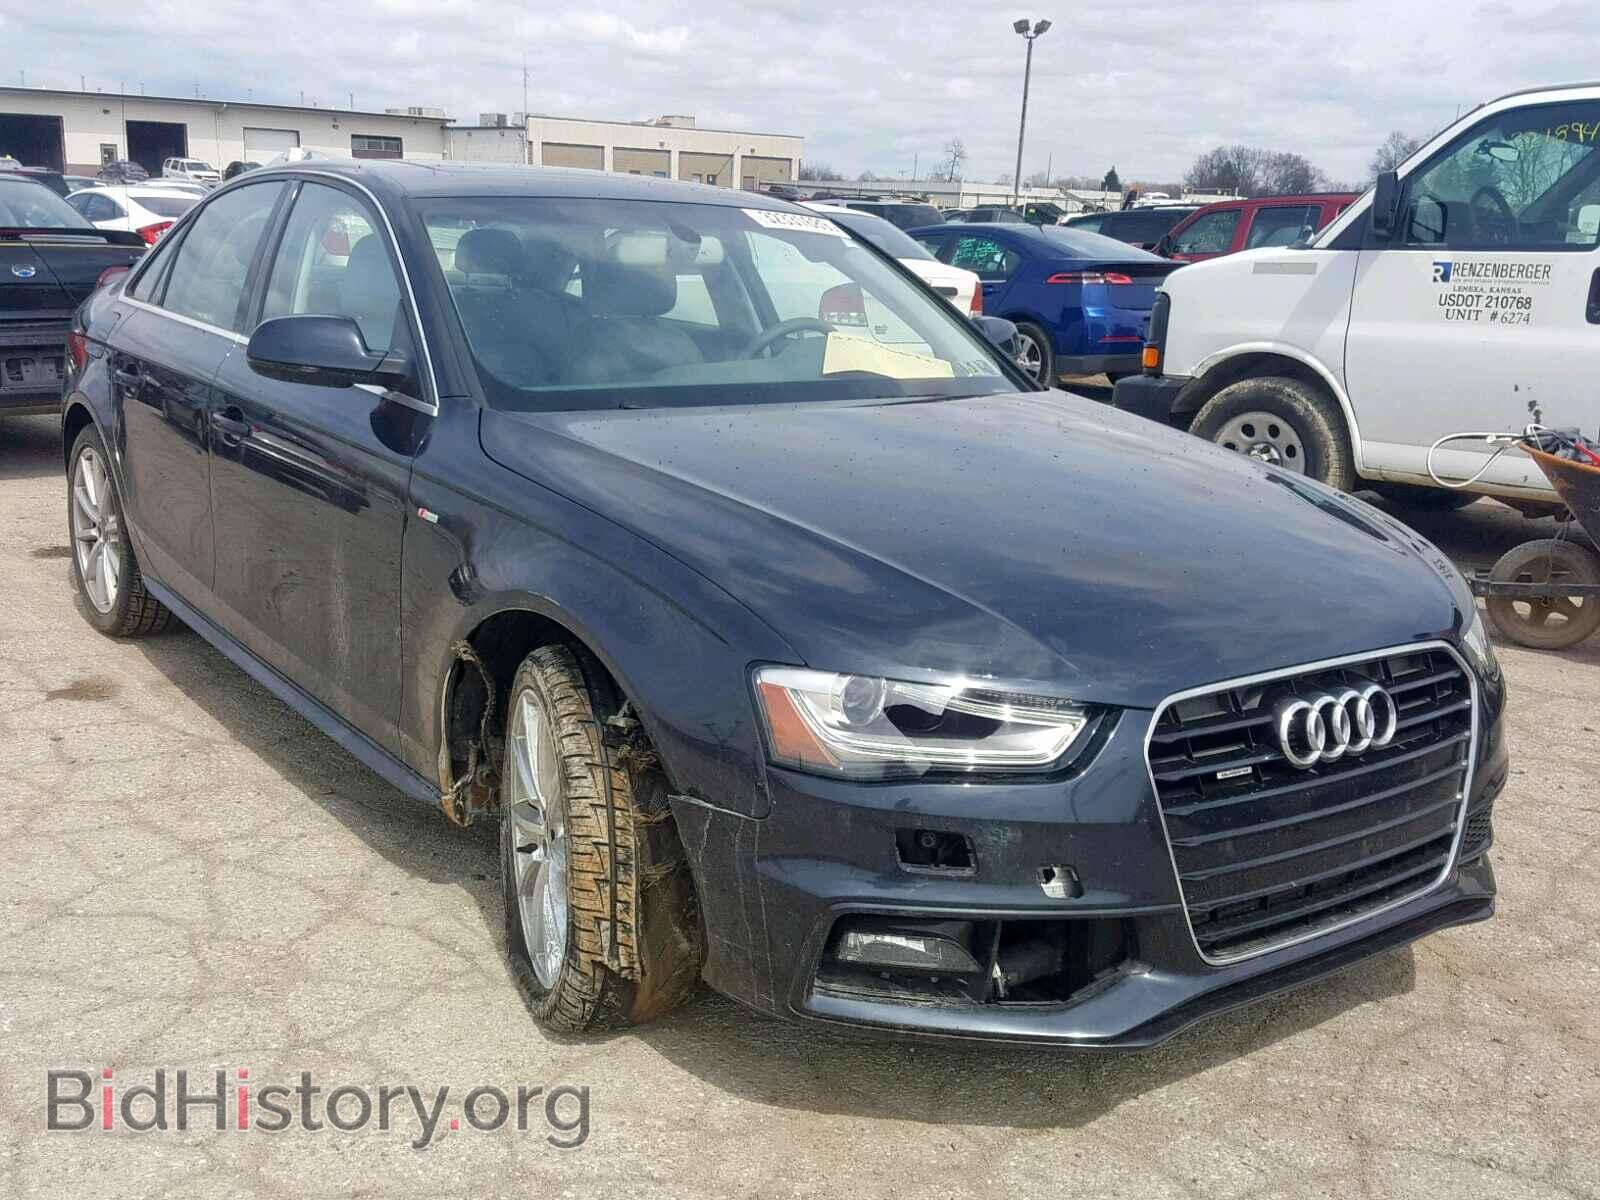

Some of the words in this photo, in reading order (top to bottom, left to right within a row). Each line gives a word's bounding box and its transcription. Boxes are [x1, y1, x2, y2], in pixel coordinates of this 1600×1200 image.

[1452, 262, 1551, 280] RENZENBERGER
[1489, 286, 1522, 294] KANSAS
[1438, 293, 1483, 307] USDOT
[1485, 295, 1532, 310] 210768
[1445, 309, 1482, 321] UNIT
